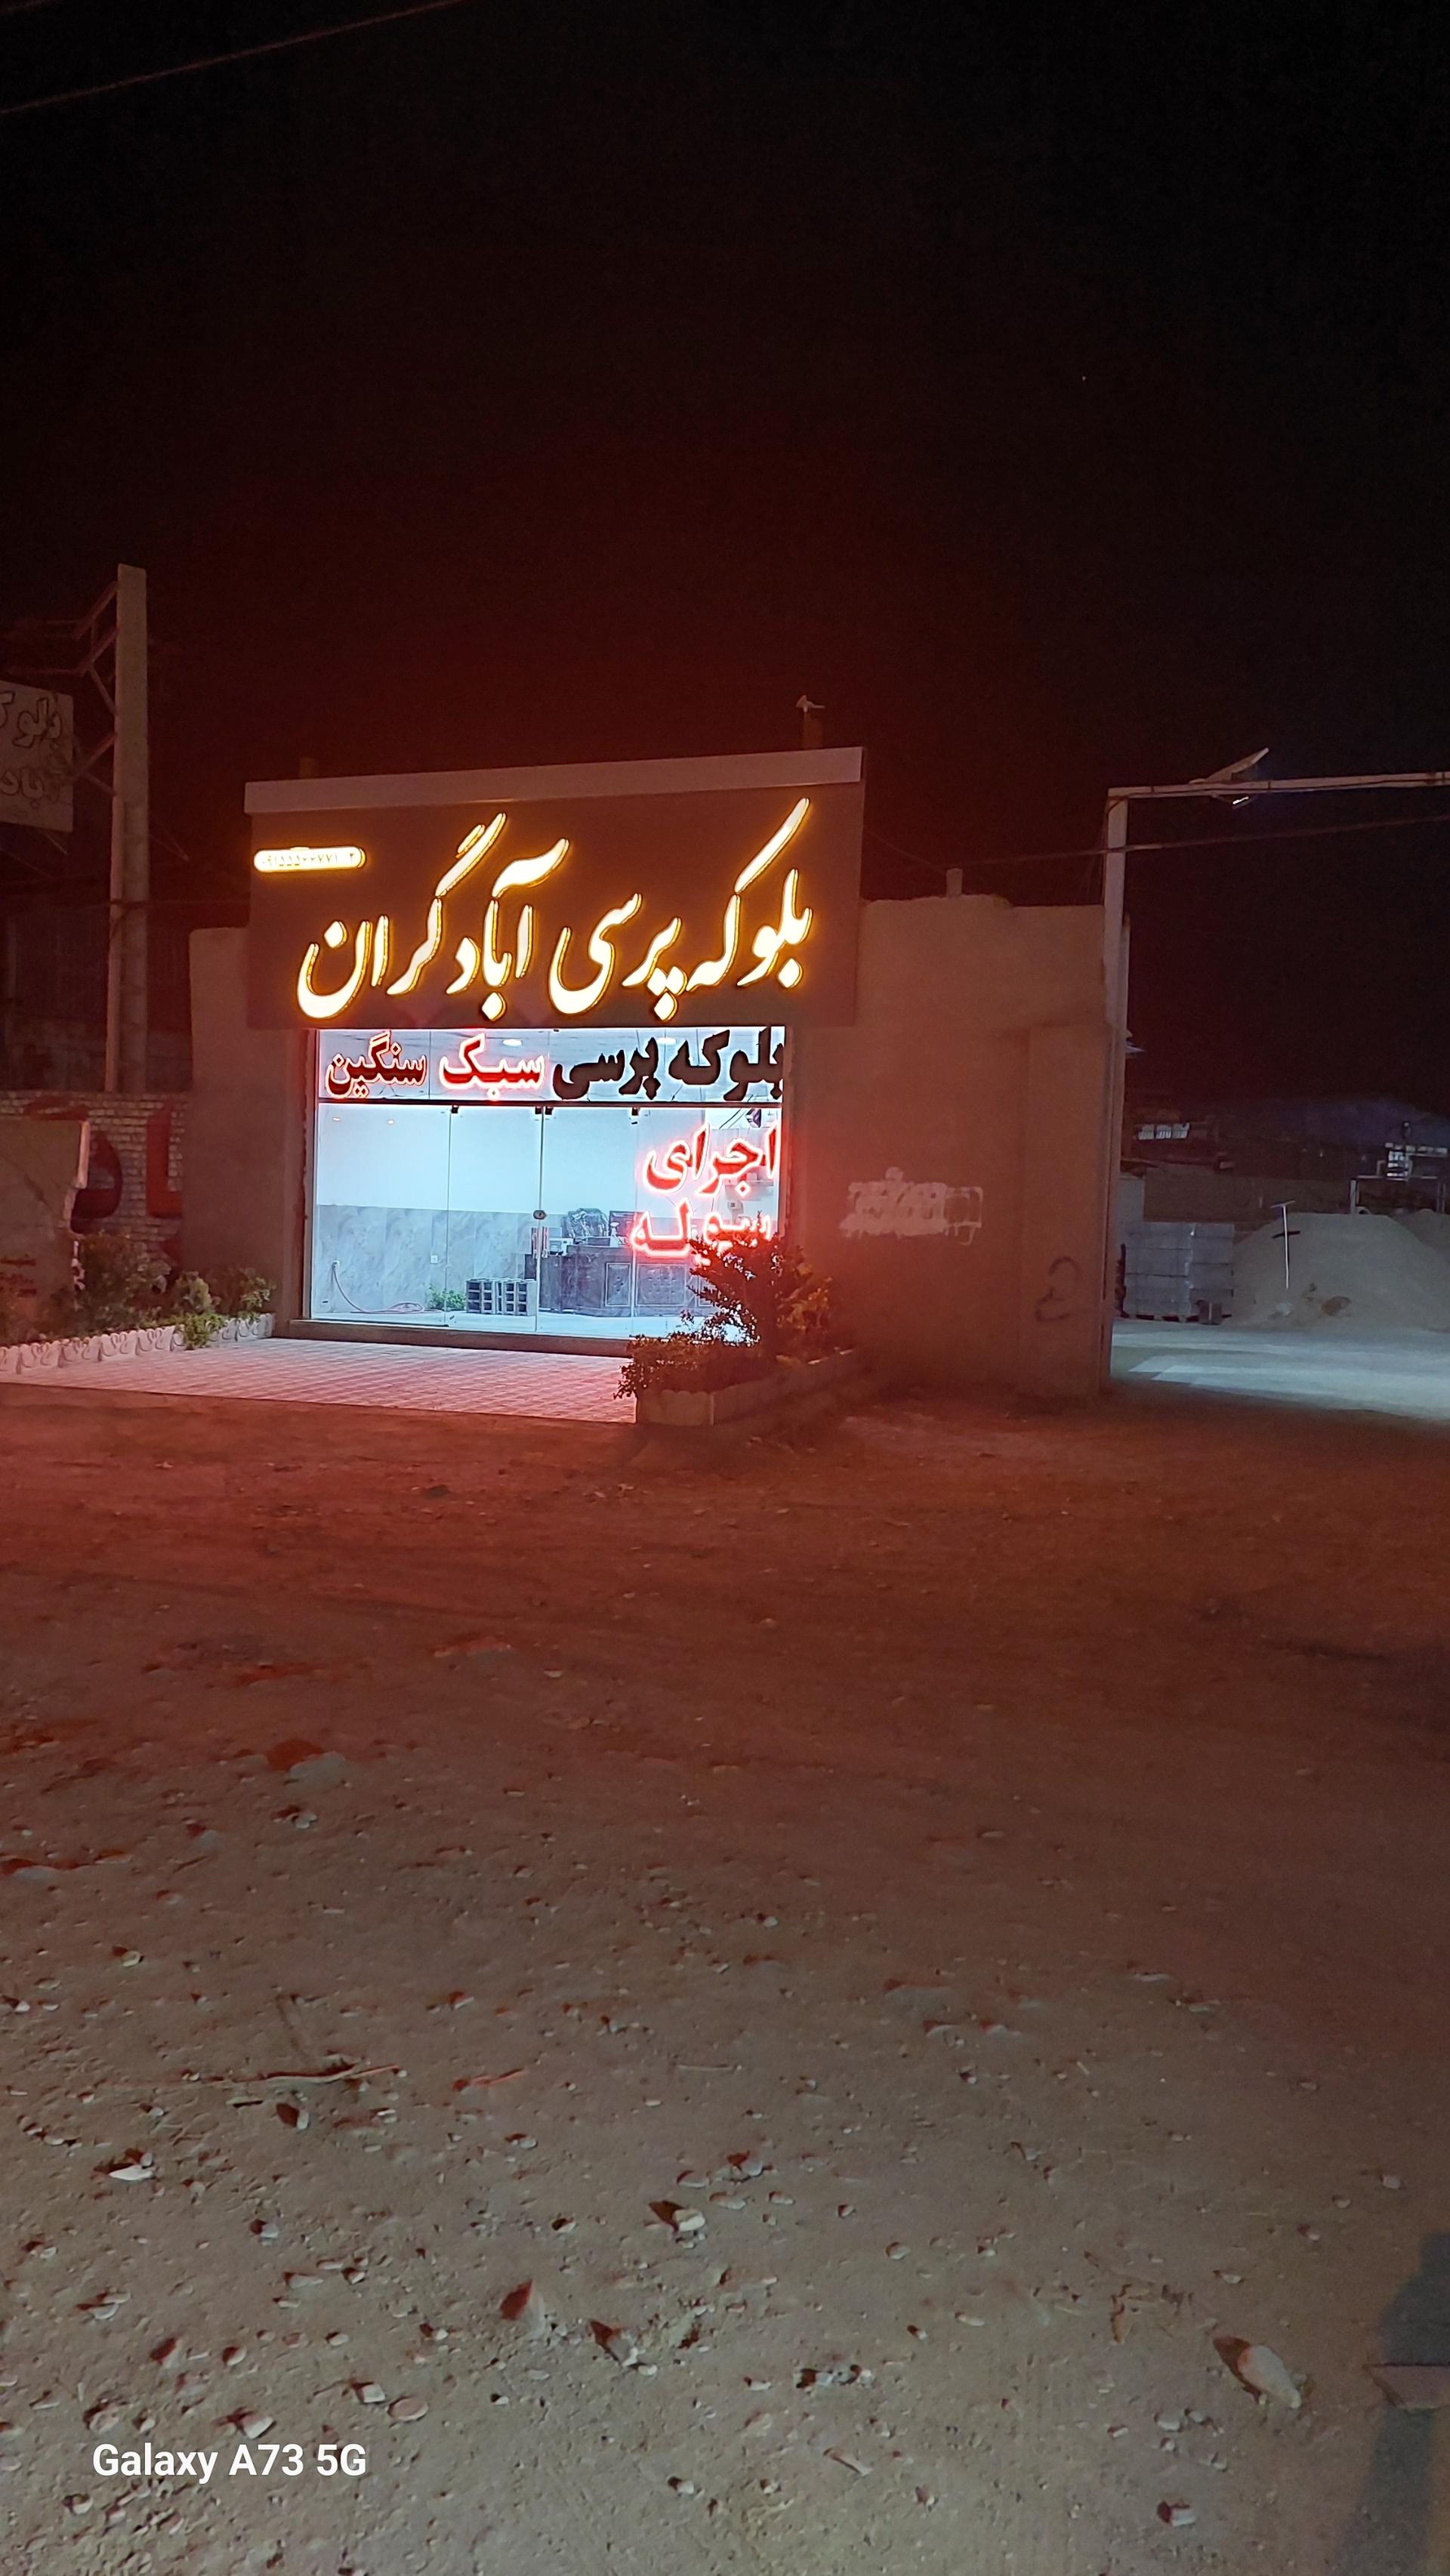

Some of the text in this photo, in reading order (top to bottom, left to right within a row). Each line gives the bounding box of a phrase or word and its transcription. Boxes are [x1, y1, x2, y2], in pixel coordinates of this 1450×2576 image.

[686, 797, 813, 989] بلوکه
[548, 893, 689, 1021] پرسی
[325, 1030, 427, 1098] سنگین
[439, 1033, 545, 1101] سبک
[552, 1037, 662, 1100] پرسی
[644, 1120, 782, 1196] اجرای
